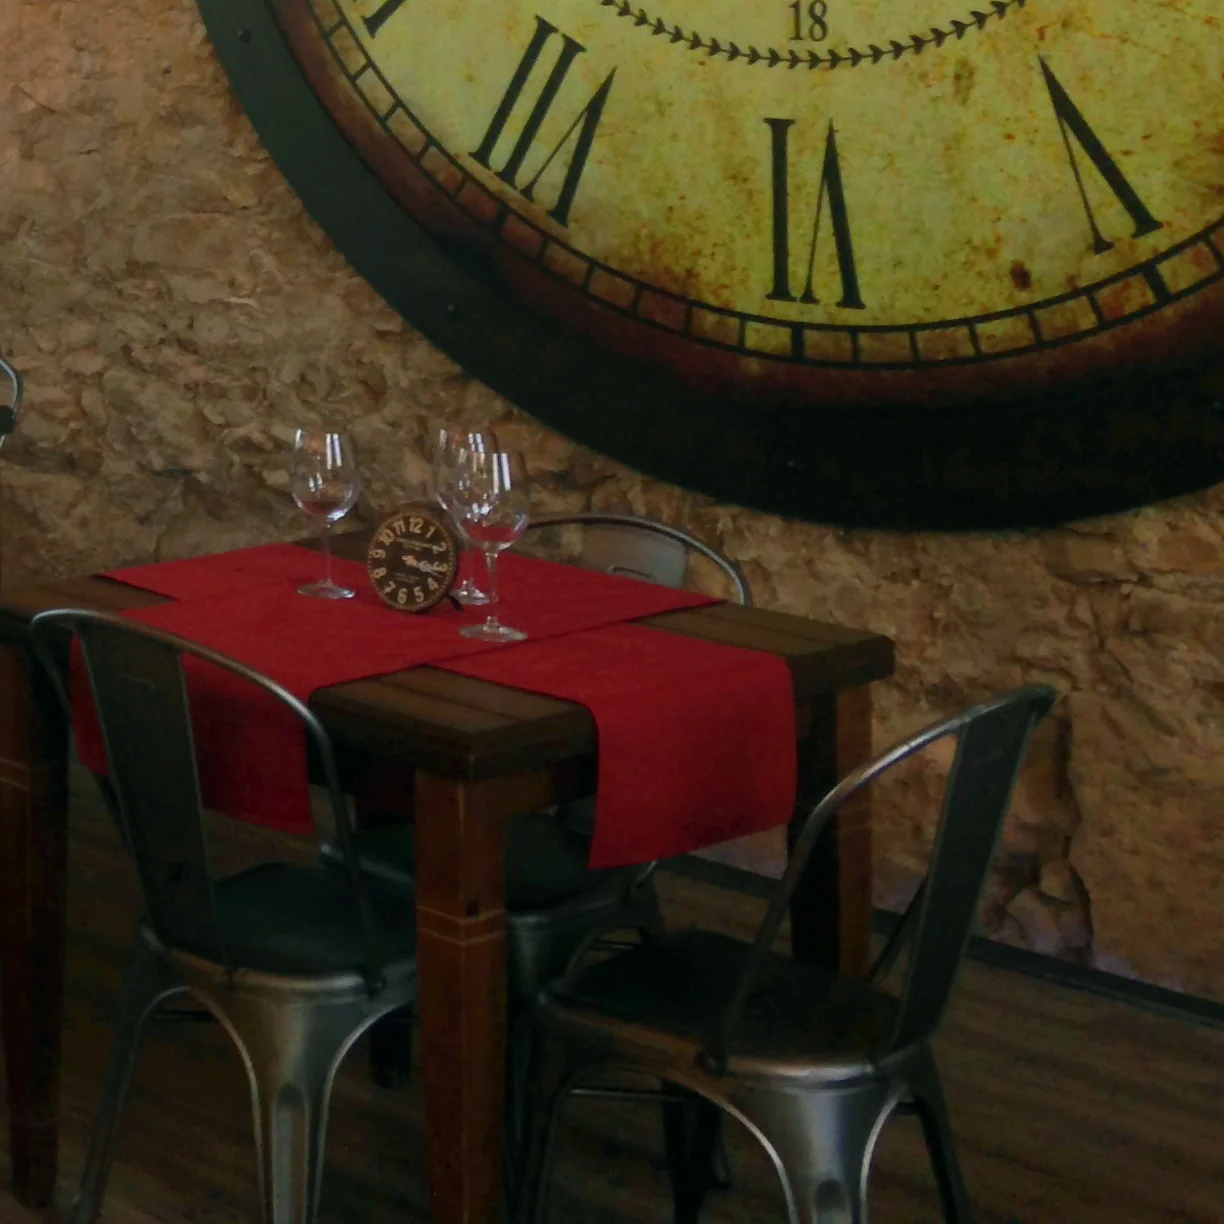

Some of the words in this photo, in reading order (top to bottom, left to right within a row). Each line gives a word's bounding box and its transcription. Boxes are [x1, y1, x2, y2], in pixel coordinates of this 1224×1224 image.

[788, 0, 829, 44] 18
[1038, 54, 1163, 255] V
[763, 117, 867, 311] VI
[393, 520, 406, 535] 11
[409, 517, 424, 534] 12
[425, 526, 436, 539] 1
[380, 529, 395, 545] 10
[371, 549, 386, 560] 9
[433, 542, 447, 554] 2
[397, 587, 408, 604] 6
[413, 586, 425, 603] 5
